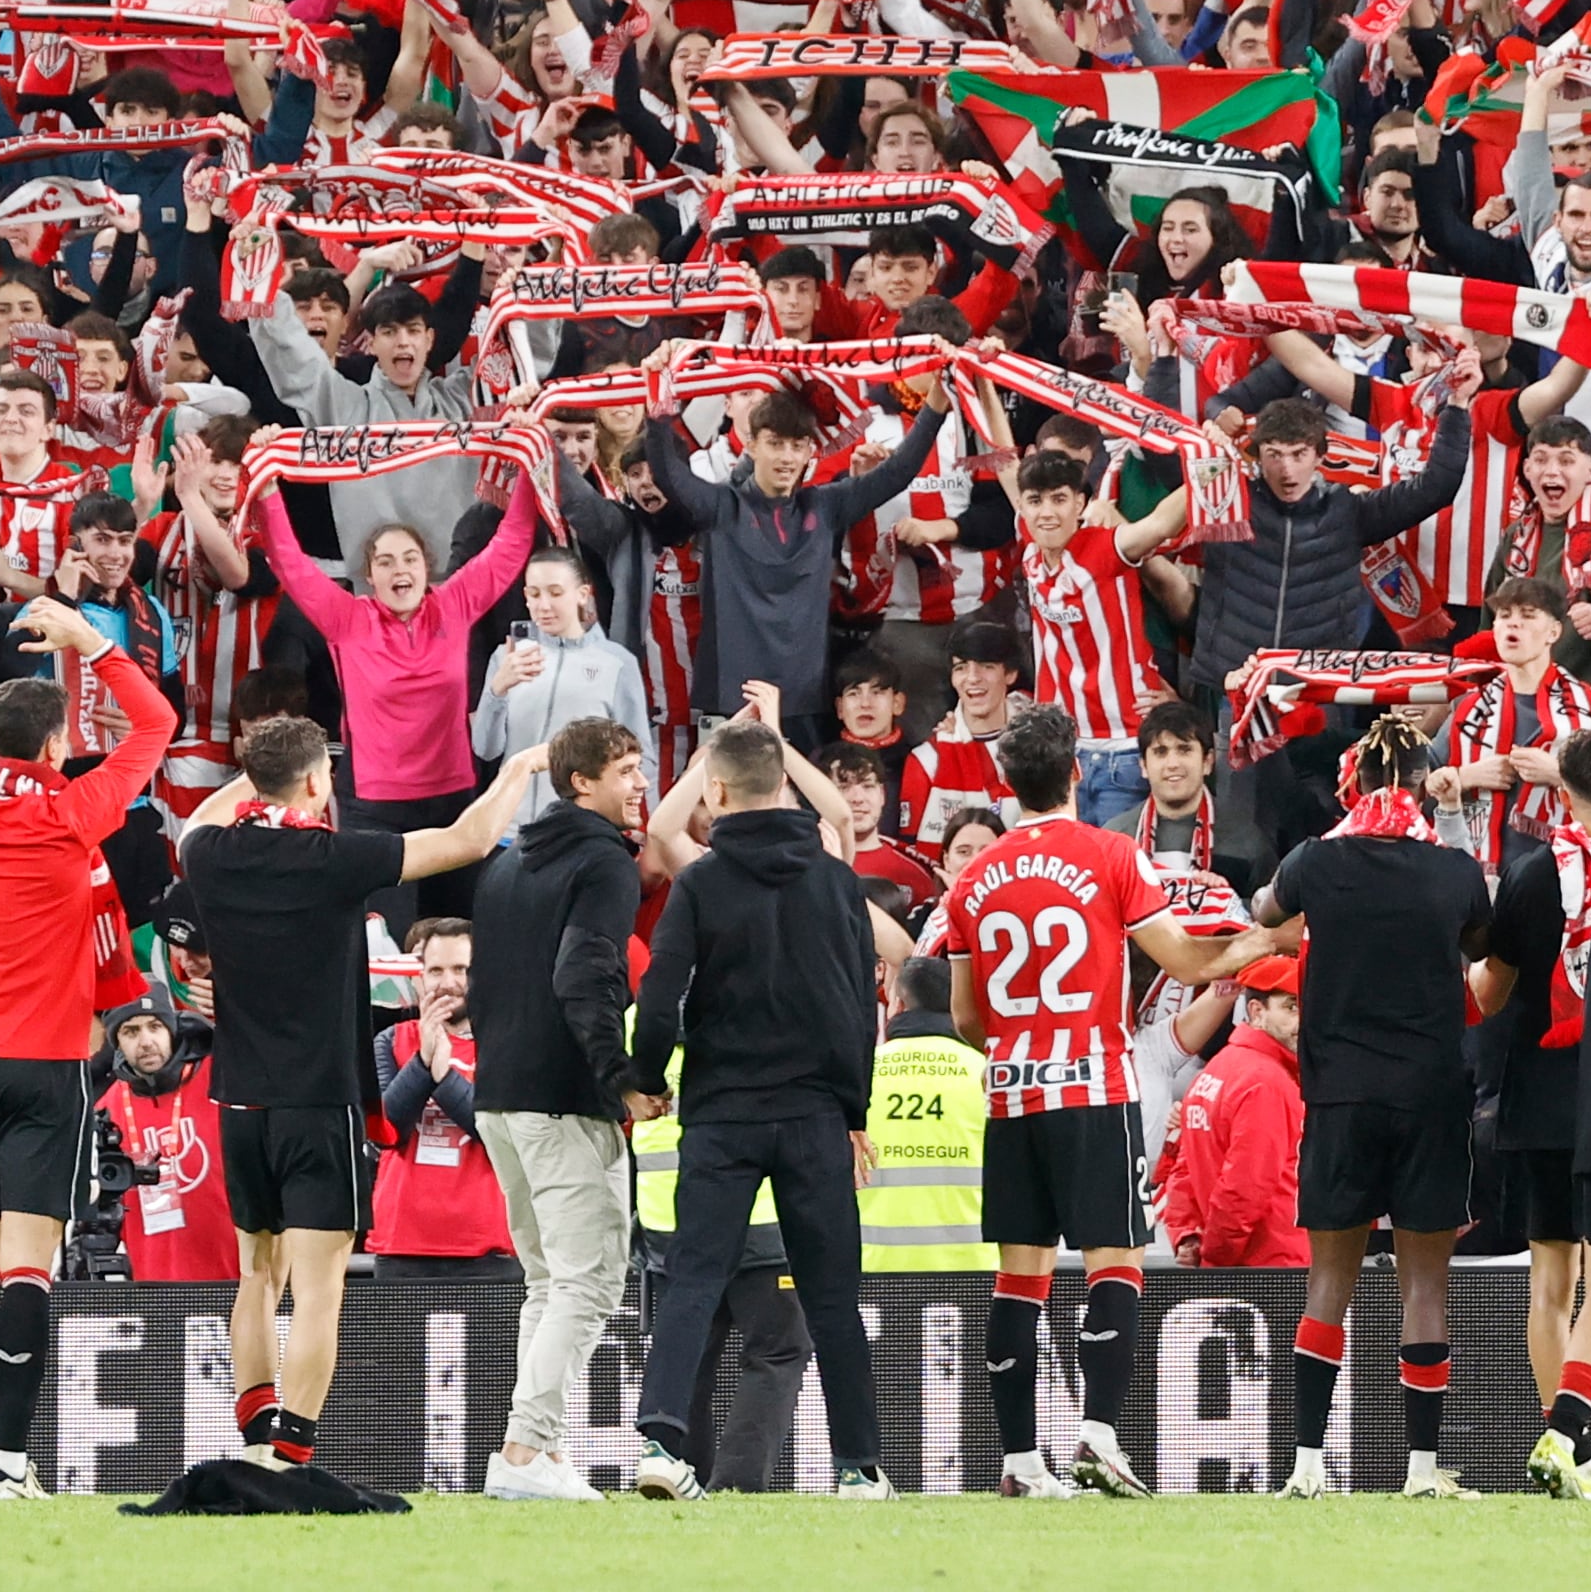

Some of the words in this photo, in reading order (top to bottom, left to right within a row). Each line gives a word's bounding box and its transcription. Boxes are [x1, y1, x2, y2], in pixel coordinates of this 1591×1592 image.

[753, 37, 968, 69] ICHH
[750, 186, 872, 208] ATHLETIC
[882, 179, 955, 204] CLUB
[768, 216, 791, 231] HAY
[791, 215, 811, 229] UN
[811, 213, 862, 230] ATHLETIC
[864, 212, 874, 227] Y
[875, 211, 891, 226] ES
[893, 211, 909, 225] EL
[510, 266, 642, 316] Athletic
[647, 261, 722, 312] Club
[297, 424, 427, 474] Athletic
[963, 863, 1013, 917] RAÚL
[1015, 852, 1098, 906] GARCÍA
[976, 904, 1093, 1015] 22
[872, 1053, 958, 1066] SEGURIDAD
[989, 1056, 1092, 1089] DIGI
[886, 1093, 944, 1121] 224
[883, 1145, 969, 1160] PROSEGUR
